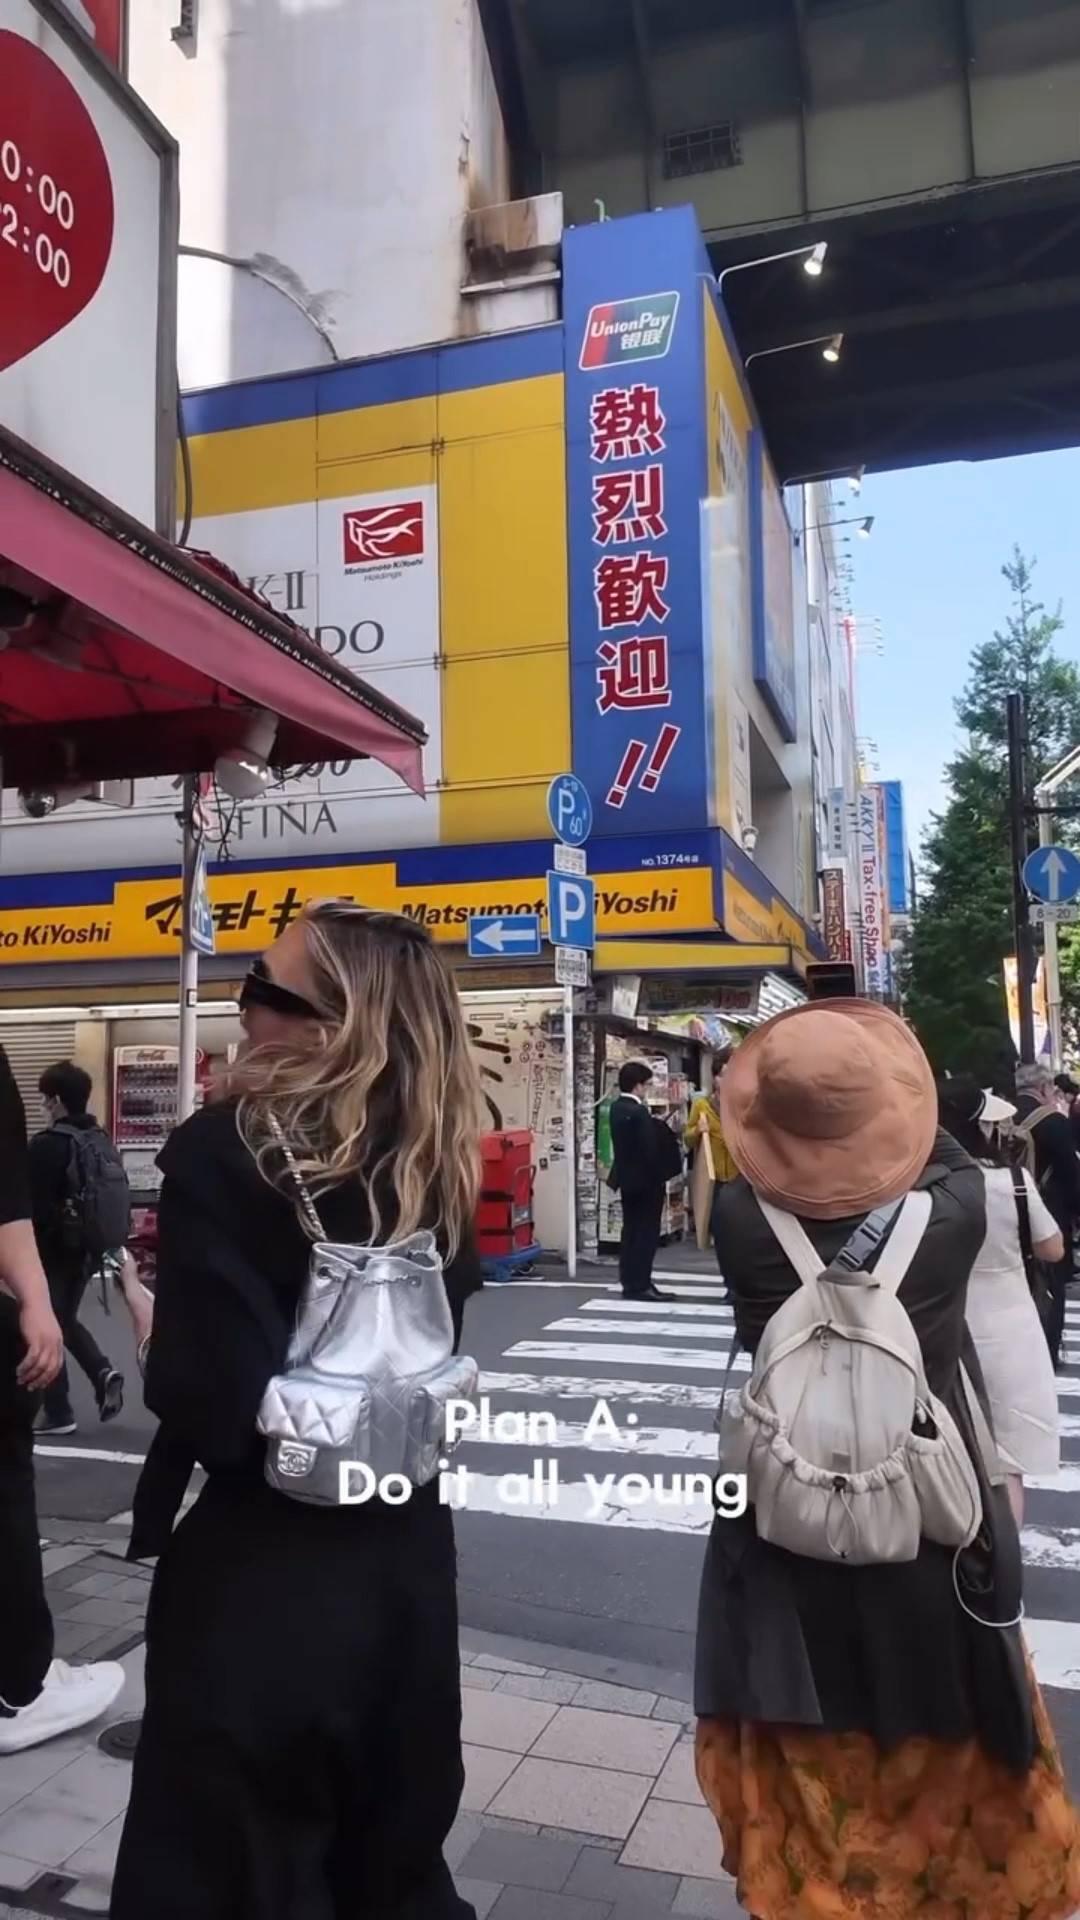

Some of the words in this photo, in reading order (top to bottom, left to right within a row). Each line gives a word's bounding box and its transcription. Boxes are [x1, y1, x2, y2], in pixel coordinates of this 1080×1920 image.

[0, 203, 71, 288] 2:00
[590, 311, 671, 338] UnionPay
[344, 563, 391, 576] Matsumoto
[364, 571, 402, 581] Holdings
[558, 788, 576, 831] P
[859, 794, 874, 842] AKKY
[558, 880, 587, 938] P
[594, 888, 678, 915] iYoshi
[23, 921, 112, 947] KiYoshi
[863, 927, 881, 968] Shop
